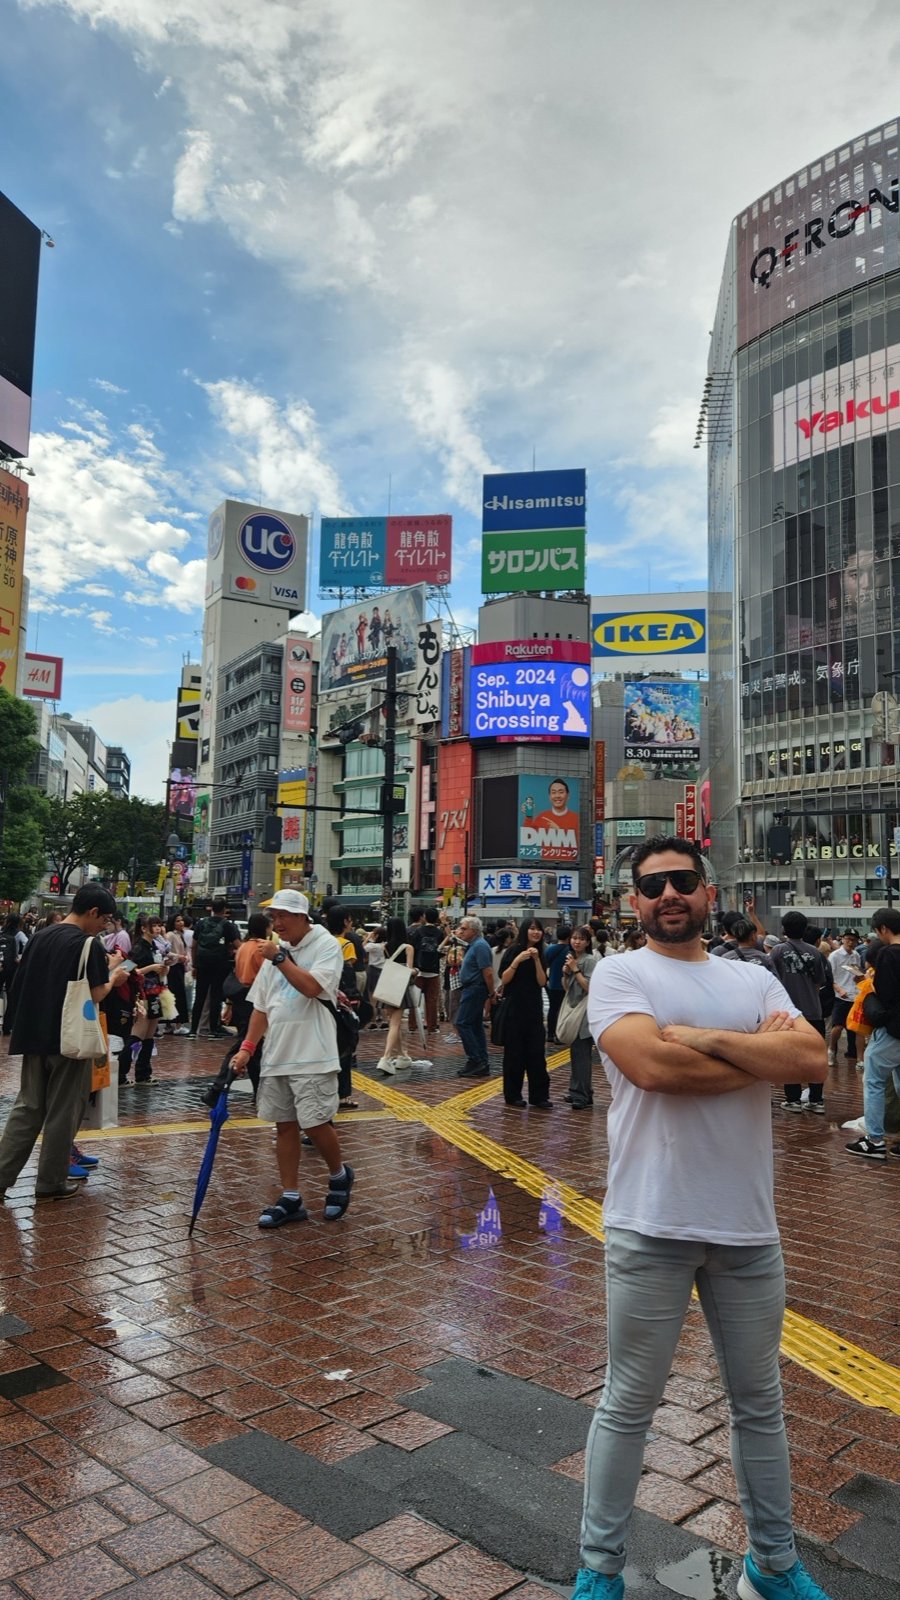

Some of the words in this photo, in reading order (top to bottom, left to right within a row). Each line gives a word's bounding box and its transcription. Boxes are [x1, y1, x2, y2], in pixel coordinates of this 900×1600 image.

[484, 495, 584, 510] Hisamitsu
[334, 531, 373, 549] 龍角散
[400, 530, 439, 548] 龍角散
[488, 547, 579, 574] サロンパス
[273, 586, 298, 599] VISA
[604, 622, 696, 643] IKEA
[505, 644, 553, 656] Rakuten
[27, 667, 51, 684] H&M
[416, 624, 440, 719] もんじゃ
[477, 672, 509, 688] Sep.
[515, 669, 556, 685] 2024
[476, 690, 550, 710] Shibuya
[475, 710, 559, 731] Crossing
[626, 748, 650, 758] 8.30
[520, 826, 577, 848] DMM
[519, 847, 578, 857] オンラインクリニック
[793, 843, 897, 860] ARBUCKS
[483, 873, 573, 891] 大盛堂店
